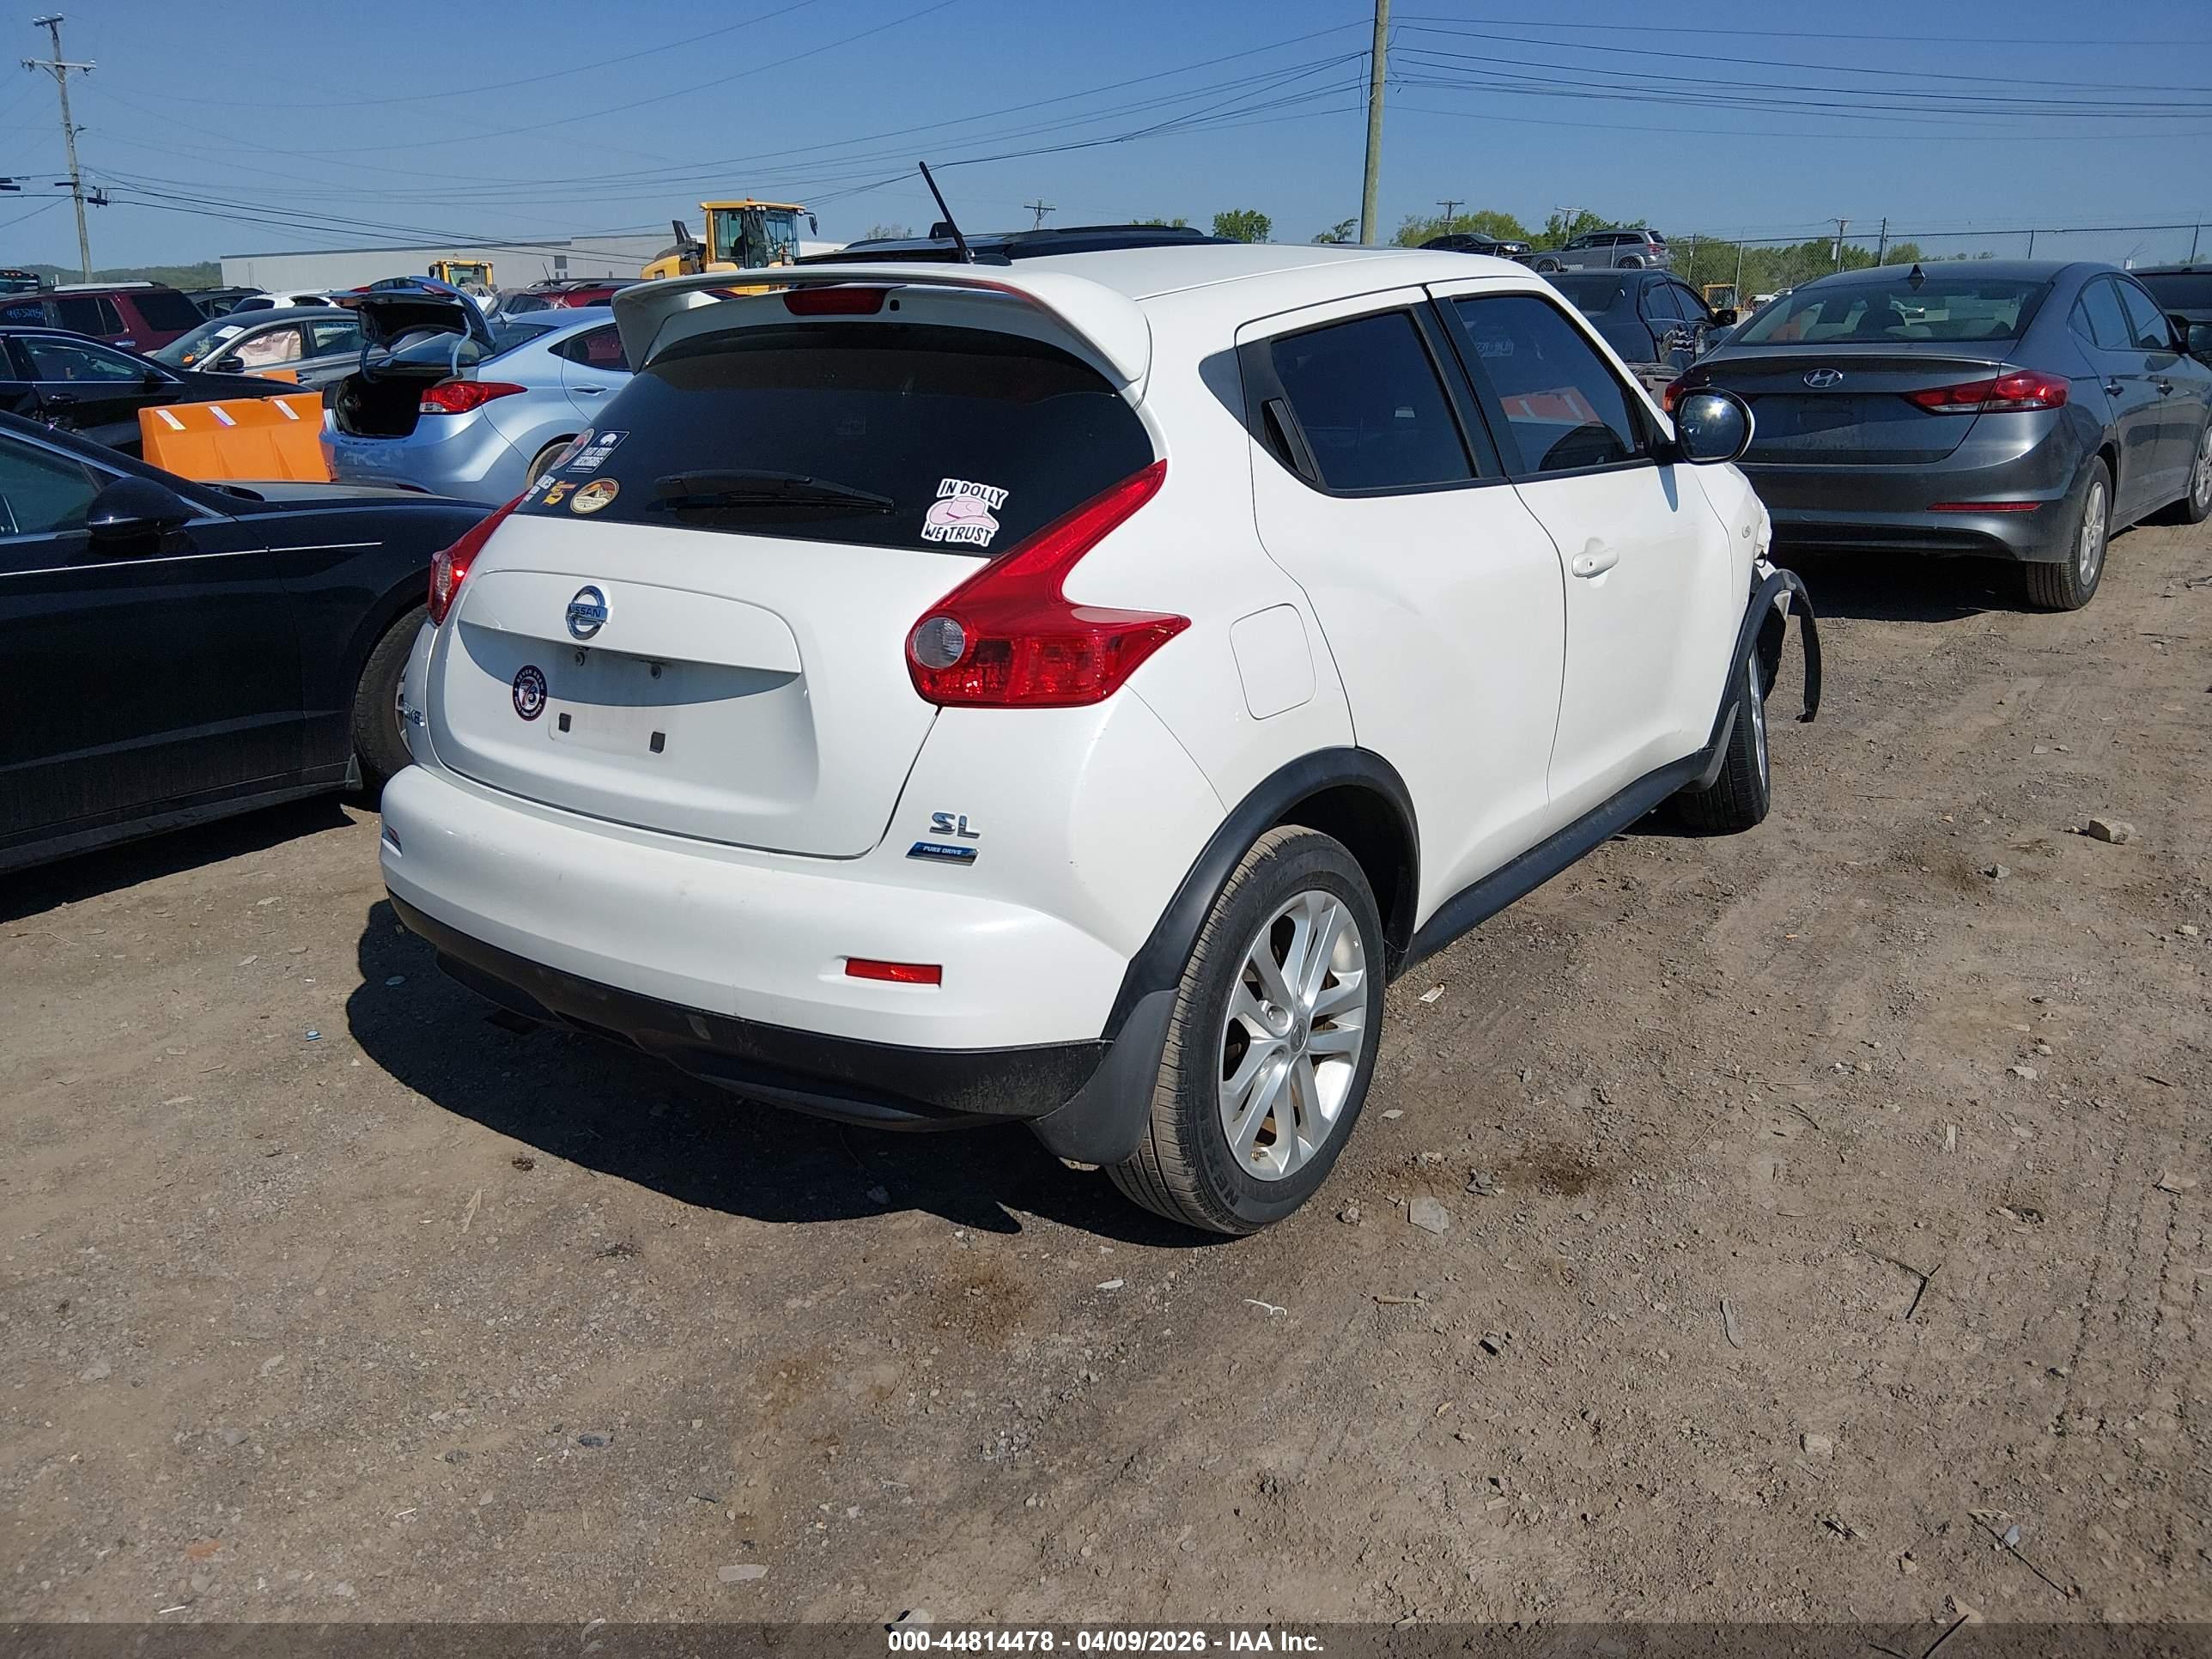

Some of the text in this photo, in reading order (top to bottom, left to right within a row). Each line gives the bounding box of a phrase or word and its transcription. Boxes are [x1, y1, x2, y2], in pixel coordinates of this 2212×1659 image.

[939, 480, 1007, 506] IN DOLLY
[925, 523, 992, 544] WE TRUST
[568, 603, 601, 619] NISSAN
[929, 811, 980, 839] SL
[922, 845, 941, 854] PURE
